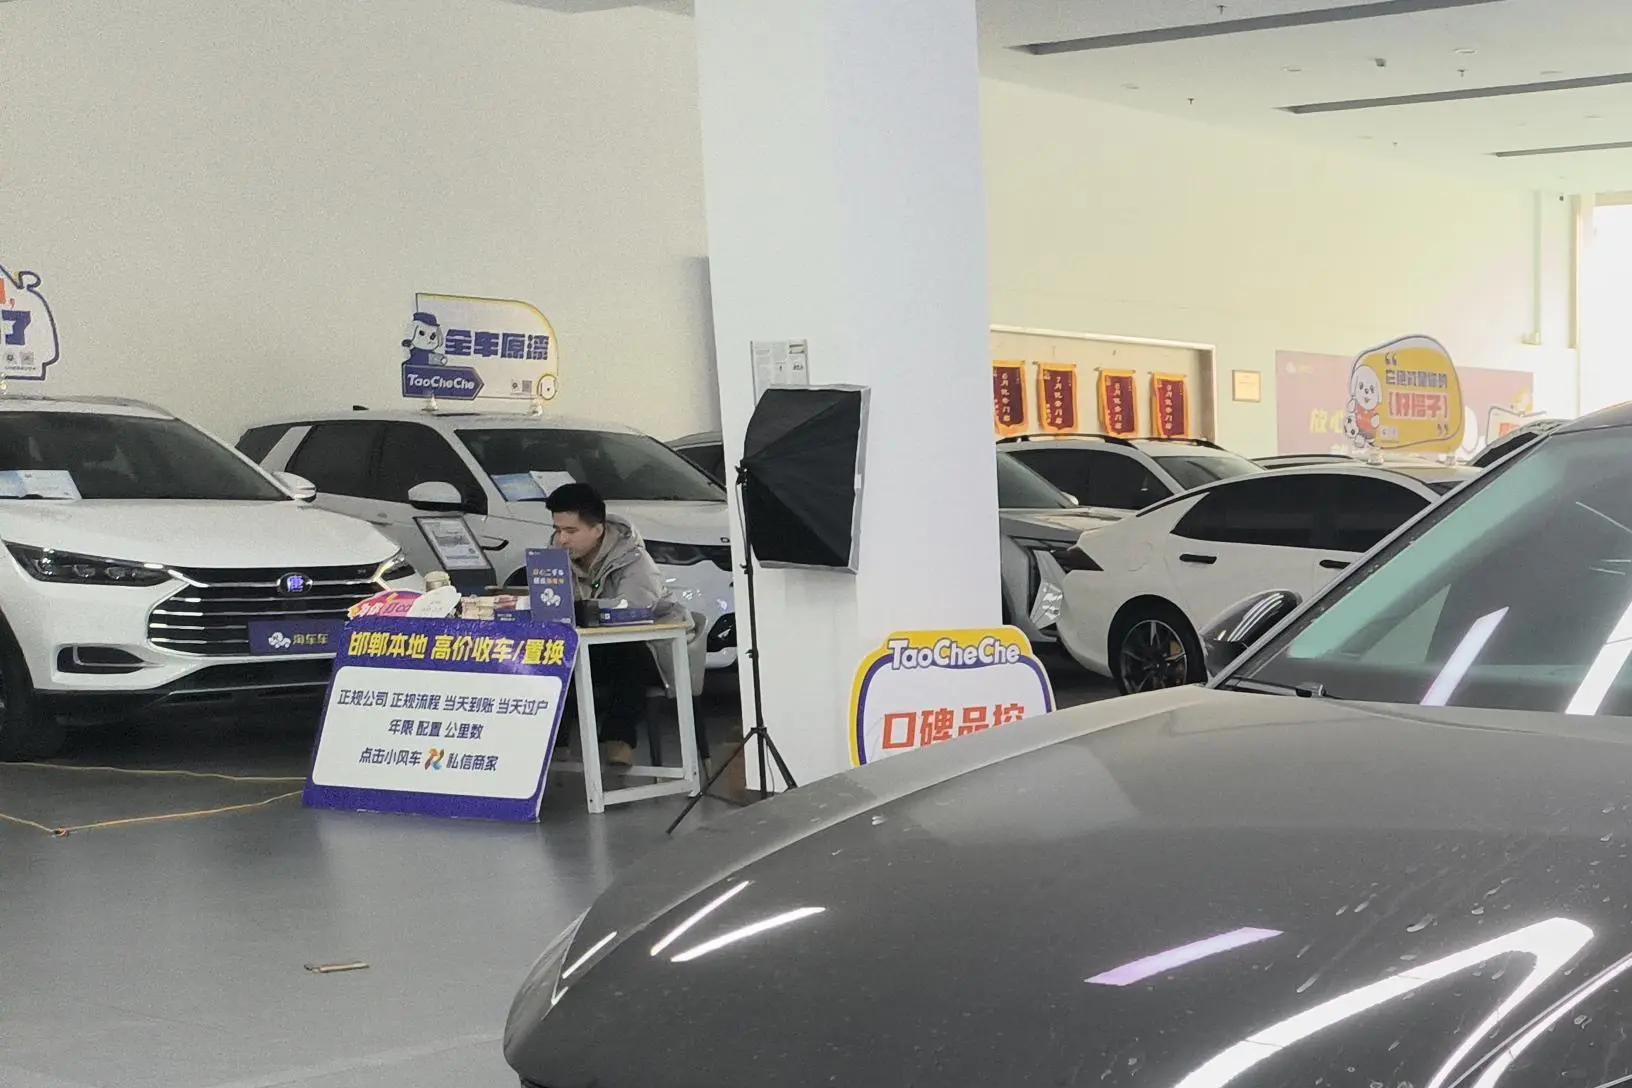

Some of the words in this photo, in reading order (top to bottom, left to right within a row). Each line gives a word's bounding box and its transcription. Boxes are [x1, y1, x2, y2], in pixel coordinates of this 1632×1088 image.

[407, 374, 475, 390] TaoCheChe
[348, 631, 428, 659] 邯郸本地
[431, 635, 565, 666] 高价收车/置换
[887, 636, 1021, 670] TaoCheChe
[337, 689, 389, 708] 正规公司
[390, 692, 441, 711] 正规流程
[443, 695, 495, 714] 当天到账
[496, 698, 549, 716] 当天过户
[388, 718, 415, 736] 年限
[415, 721, 443, 737] 配置
[444, 721, 484, 740] 公里数
[358, 747, 423, 766] 点击小风车
[446, 752, 499, 772] 私信商家
